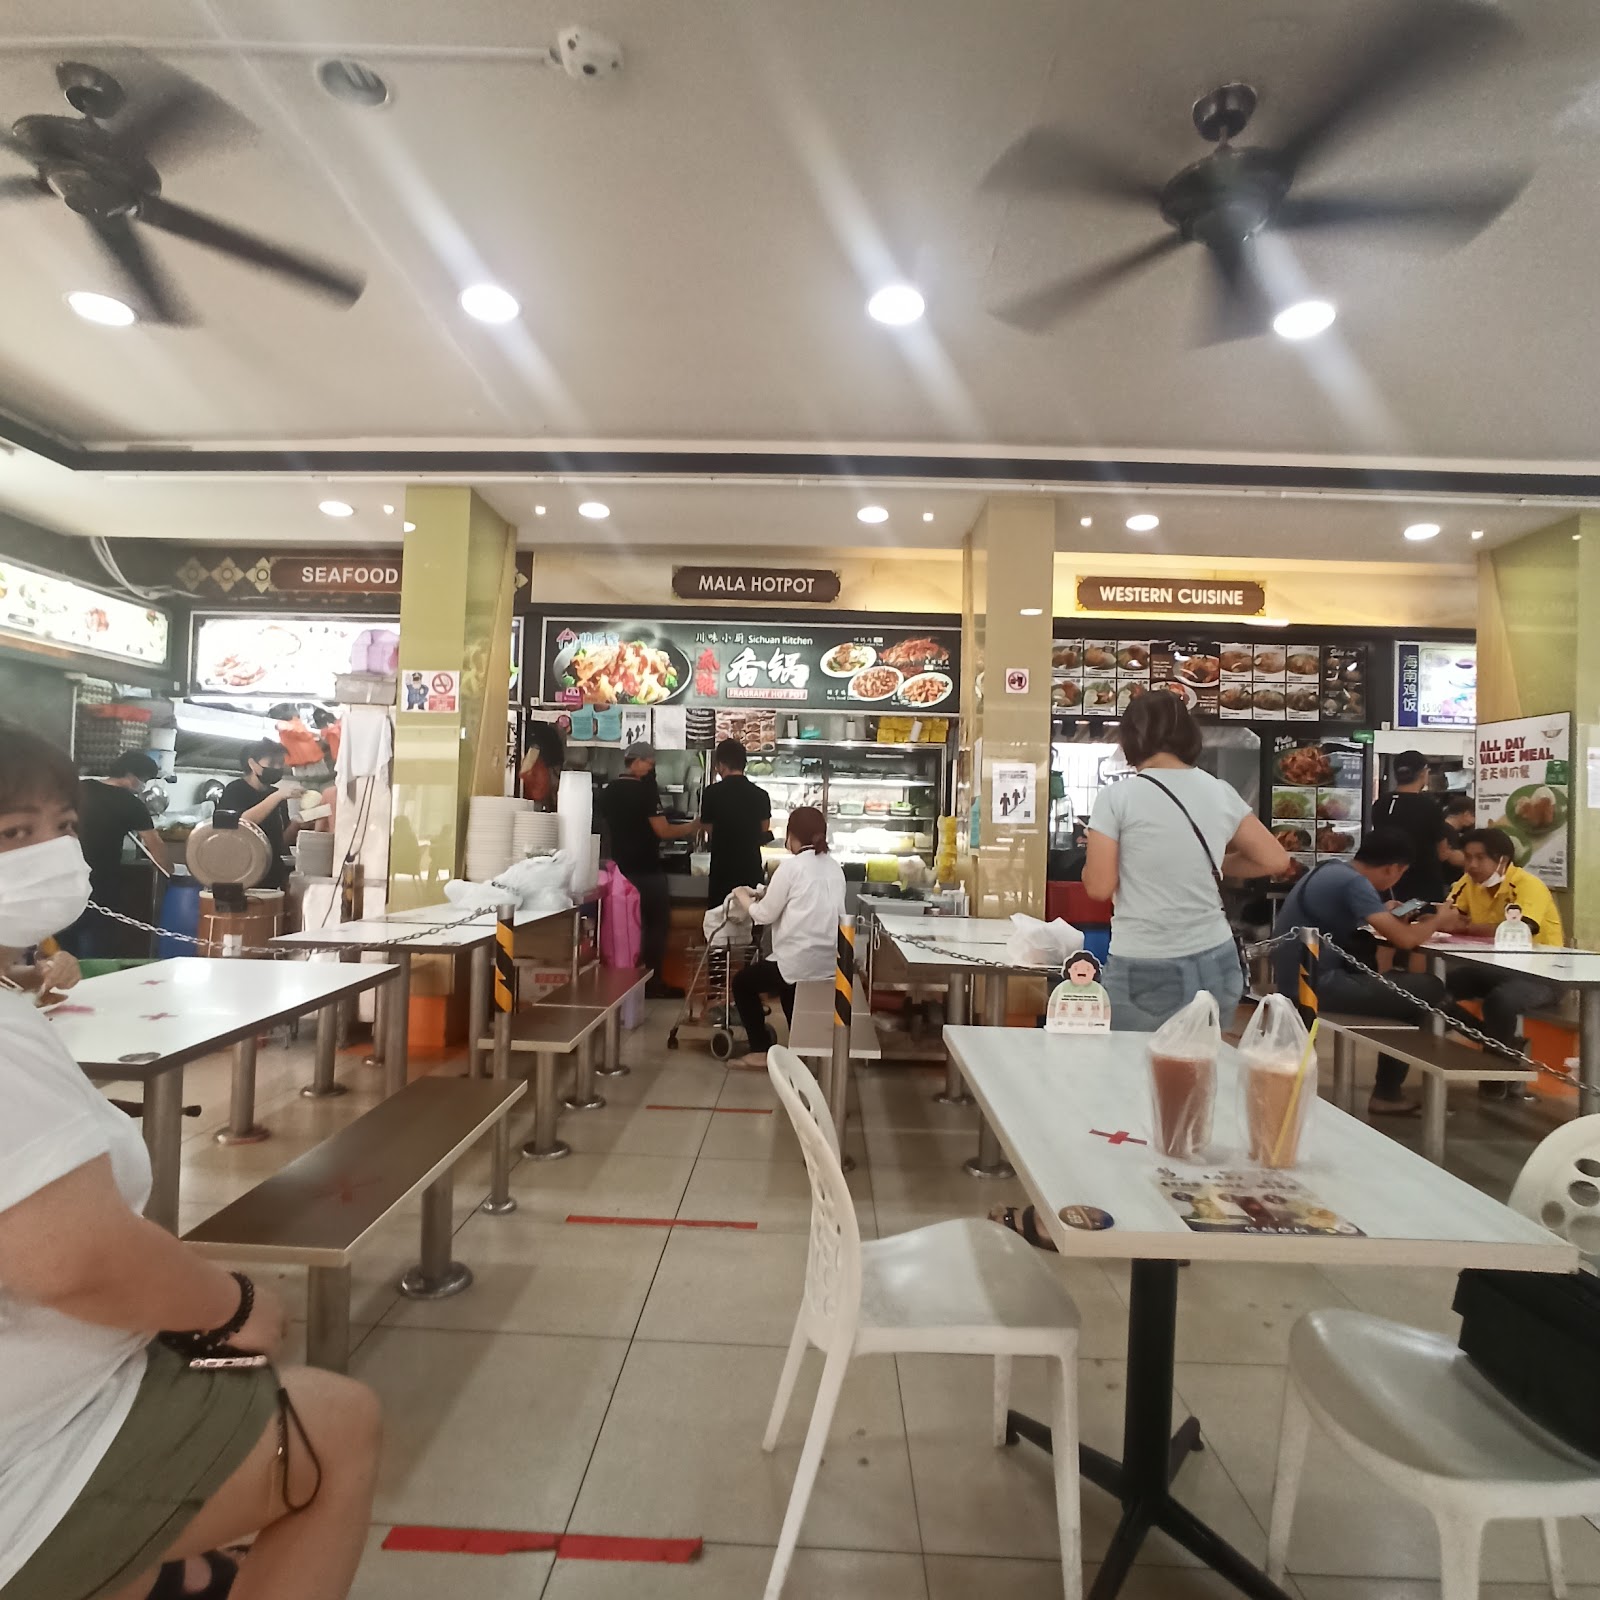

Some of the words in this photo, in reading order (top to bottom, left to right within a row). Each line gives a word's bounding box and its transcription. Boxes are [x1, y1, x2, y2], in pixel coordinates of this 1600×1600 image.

[301, 566, 399, 584] SEAFOOD
[698, 574, 746, 592] MALA
[750, 575, 816, 594] HOTPOT
[1099, 585, 1173, 604] WESTERN
[1177, 588, 1244, 606] CUISINE
[695, 631, 744, 645] 川味小厨
[748, 634, 781, 645] Sichuan
[782, 635, 814, 646] Kitchen
[726, 646, 810, 688] 香锅
[1402, 654, 1418, 713] 海南鸡饭
[729, 688, 769, 698] FRAGRANT
[771, 689, 788, 699] HOT
[789, 689, 806, 699] POT
[1479, 739, 1501, 752] ALL
[1504, 736, 1526, 750] DAY
[1479, 750, 1516, 765] VALUE
[1519, 747, 1554, 762] MEAL
